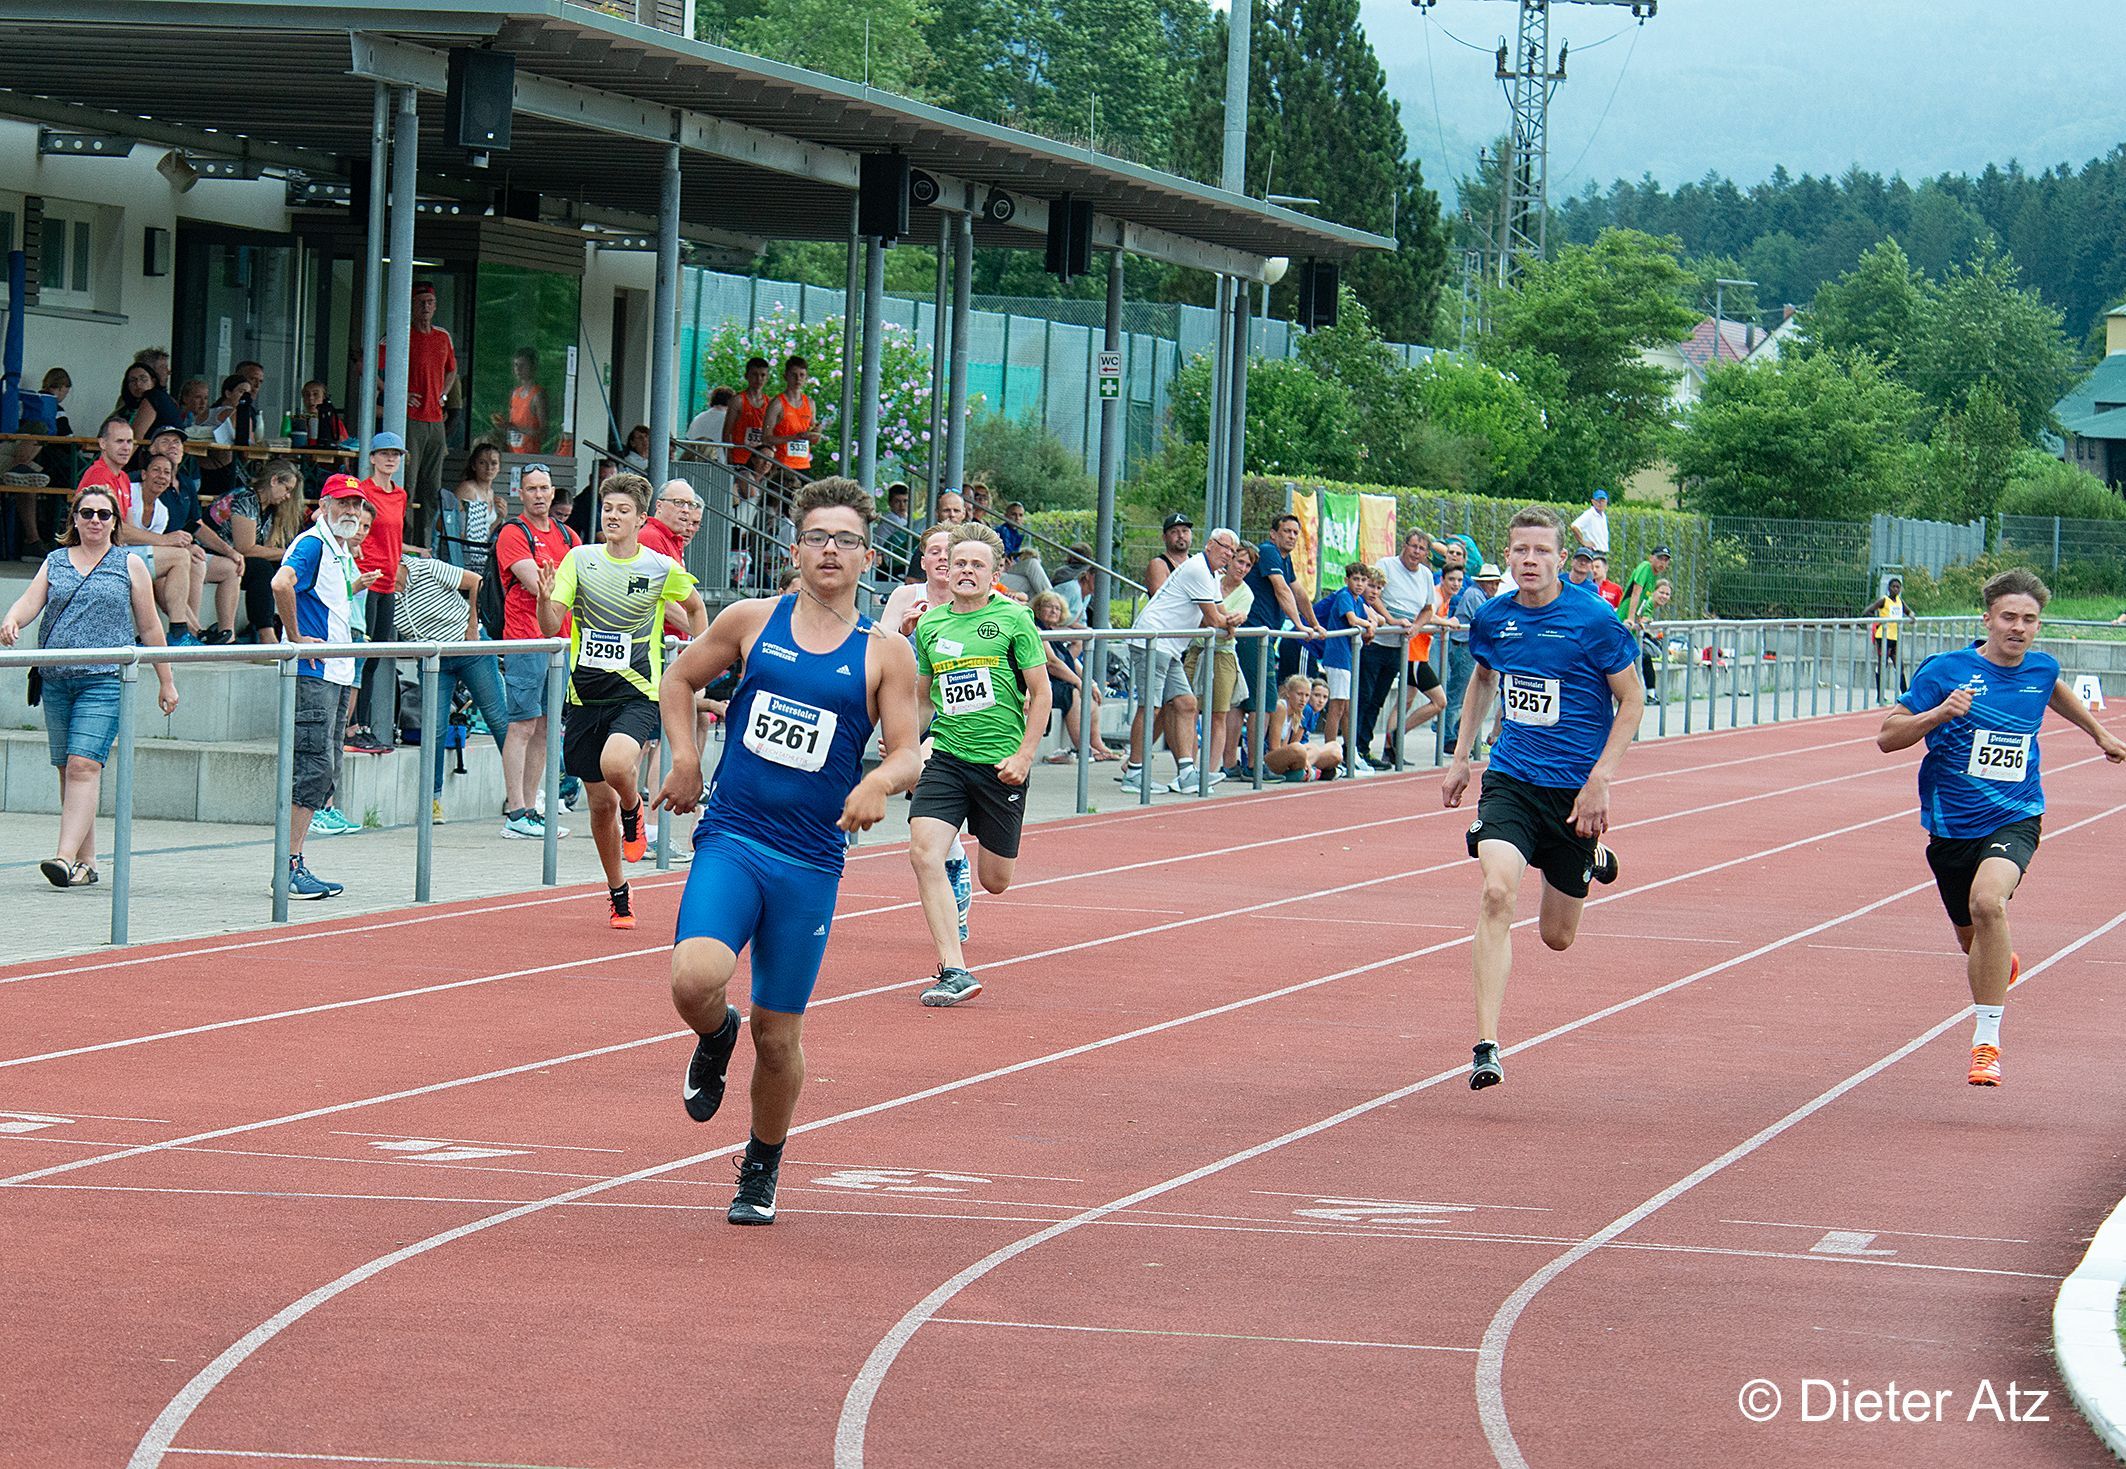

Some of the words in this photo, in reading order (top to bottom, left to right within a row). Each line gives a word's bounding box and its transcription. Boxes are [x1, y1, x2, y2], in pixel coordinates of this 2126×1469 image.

[1101, 356, 1119, 366] WC
[585, 641, 625, 660] 5298
[945, 682, 987, 704] 5264
[1508, 689, 1552, 713] 5257
[2083, 684, 2091, 700] 5
[772, 700, 817, 721] Peterstaler
[755, 713, 820, 755] 5261
[1978, 746, 2024, 769] 5256
